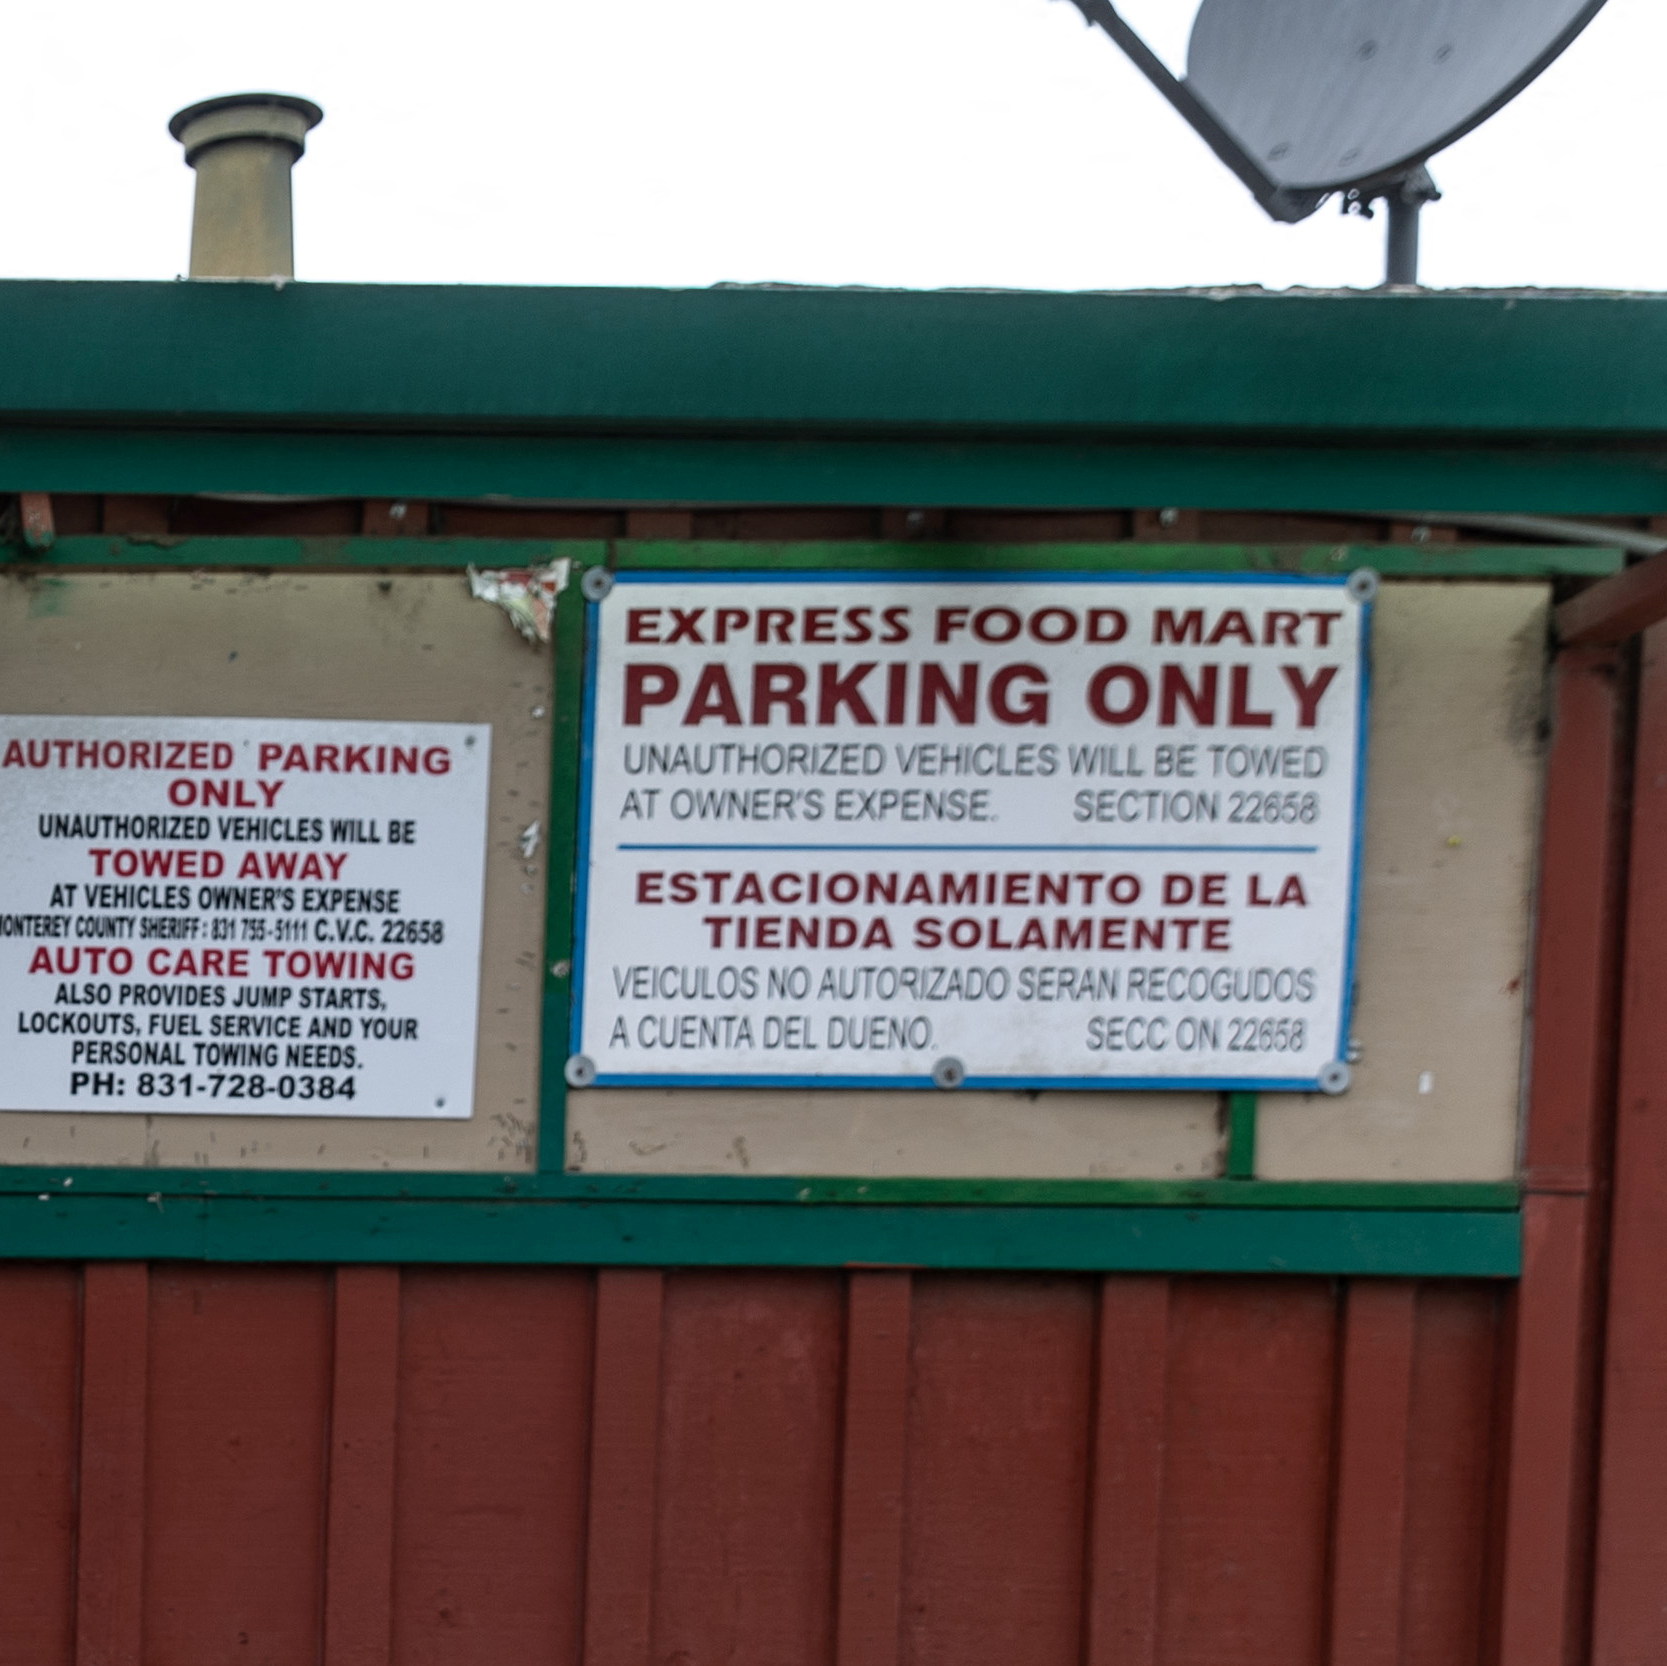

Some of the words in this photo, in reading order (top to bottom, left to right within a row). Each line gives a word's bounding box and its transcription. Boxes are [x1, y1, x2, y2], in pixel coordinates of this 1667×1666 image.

[626, 606, 911, 644] EXPRESS
[935, 606, 1128, 644] FOOD
[1152, 608, 1342, 647] MART
[624, 662, 1049, 726] PARKING
[1087, 663, 1338, 728] ONLY
[2, 739, 233, 770] AUTHORIZED
[259, 743, 450, 775] PARKING
[624, 743, 886, 776] UNAUTHORIZED
[895, 743, 1058, 776] VEHICLES
[1068, 744, 1144, 777] WILL
[1154, 744, 1197, 777] BE
[1207, 744, 1327, 779] TOWED
[168, 778, 283, 808] ONLY
[620, 789, 661, 819] AT
[671, 789, 824, 821] OWNER'S
[835, 789, 1000, 822] EXPENSE.
[1074, 789, 1219, 823] SECTION
[1228, 791, 1318, 824] 22658
[39, 814, 210, 840] UNAUTHORIZED
[218, 817, 323, 842] VEHICLES
[330, 820, 380, 844] WILL
[388, 820, 415, 844] BE
[89, 849, 224, 878] TOWED
[238, 852, 347, 880] AWAY
[50, 884, 77, 907] AT
[85, 884, 190, 909] VEHICLES
[198, 886, 294, 911] OWNER'S
[302, 888, 399, 913] EXPENSE
[637, 872, 1141, 905] ESTACIONAMIENTO
[1163, 874, 1227, 906] DE
[1248, 874, 1307, 906] LA
[76, 915, 136, 938] COUNTY
[211, 917, 235, 940] 831
[314, 918, 374, 943] C.V.C.
[381, 919, 443, 944] 22658
[703, 917, 893, 949] TIENDA
[915, 917, 1230, 951] SOLAMENTE
[29, 946, 133, 975] AUTO
[148, 948, 249, 977] CARE
[263, 950, 413, 980] TOWING
[55, 983, 111, 1005] ALSO
[119, 984, 225, 1007] PROVIDES
[233, 986, 292, 1008] JUMP
[299, 987, 386, 1010] STARTS,
[613, 966, 758, 1000] VEICULOS
[768, 966, 810, 1000] NO
[818, 966, 1010, 1001] AUTORIZADO
[1017, 966, 1118, 1001] SERAN
[1127, 967, 1314, 1002] RECOGUDOS
[18, 1012, 140, 1035] LOCKOUTS,
[149, 1014, 202, 1036] FUEL
[210, 1015, 301, 1038] SERVICE
[308, 1017, 352, 1038] AND
[360, 1018, 418, 1040] YOUR
[609, 1016, 629, 1048] A
[638, 1015, 754, 1049] CUENTA
[763, 1016, 817, 1049] DEL
[1227, 1017, 1305, 1052] 22658
[72, 1040, 185, 1066] PERSONAL
[193, 1043, 278, 1067] TOWING
[286, 1044, 362, 1069] NEEDS.
[71, 1072, 124, 1095] PH:
[137, 1073, 355, 1100] 831-728-0384
